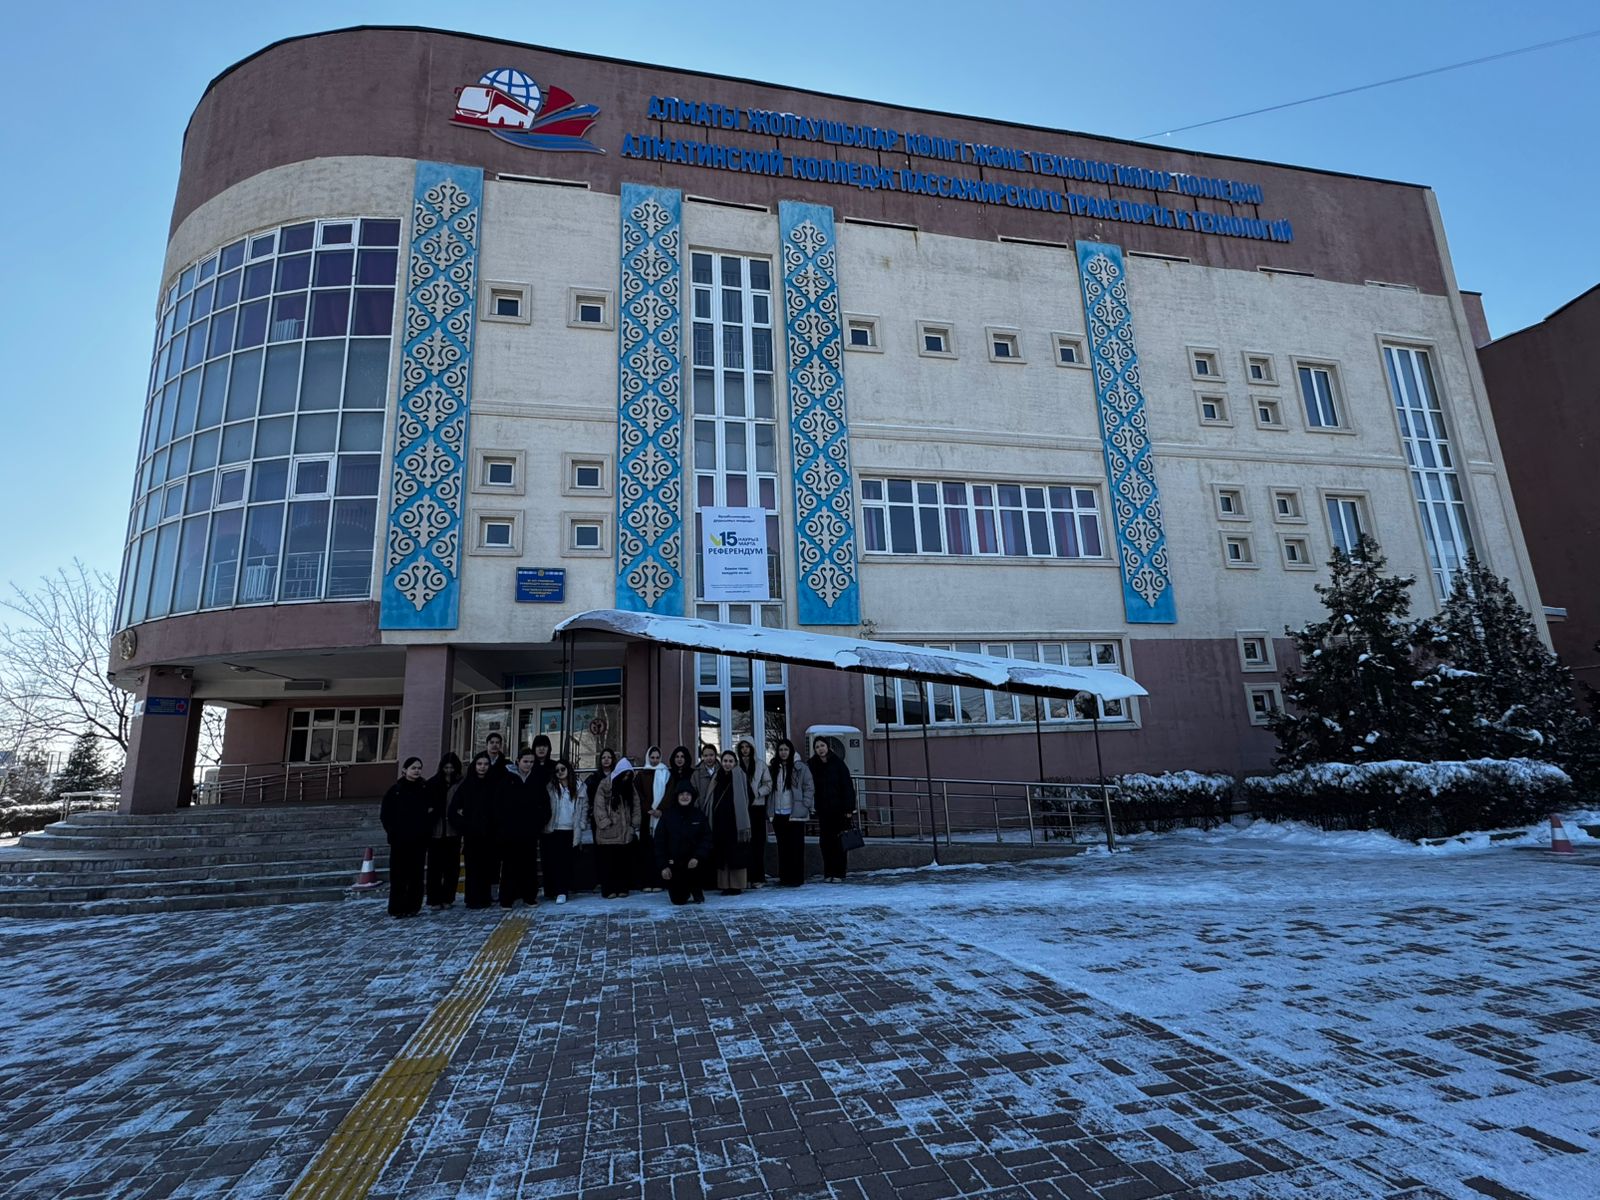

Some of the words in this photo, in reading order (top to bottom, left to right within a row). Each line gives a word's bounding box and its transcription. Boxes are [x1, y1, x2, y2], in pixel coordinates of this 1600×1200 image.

[648, 95, 740, 130] АЛМАТЫ
[747, 107, 899, 151] ЖОЛАУШЫЛАР
[972, 143, 1026, 171] ЖӘНЕ
[1029, 151, 1172, 191] ТЕХНОЛОГИЯЛАР
[1175, 173, 1265, 206] КОЛЛЕДЖІ
[621, 132, 785, 177] АЛМАТИНСКИЙ
[791, 155, 895, 191] КОЛЛЕДЖ
[899, 168, 1063, 213] ПАССАЖИРСКОГО
[1065, 192, 1174, 228] ТРАНСПОРТА
[1174, 208, 1190, 230] И
[1190, 210, 1295, 243] ТЕХНОЛОГИЙ
[708, 547, 763, 556] РЕФЕРЕНДУМ
[719, 531, 738, 547] 15
